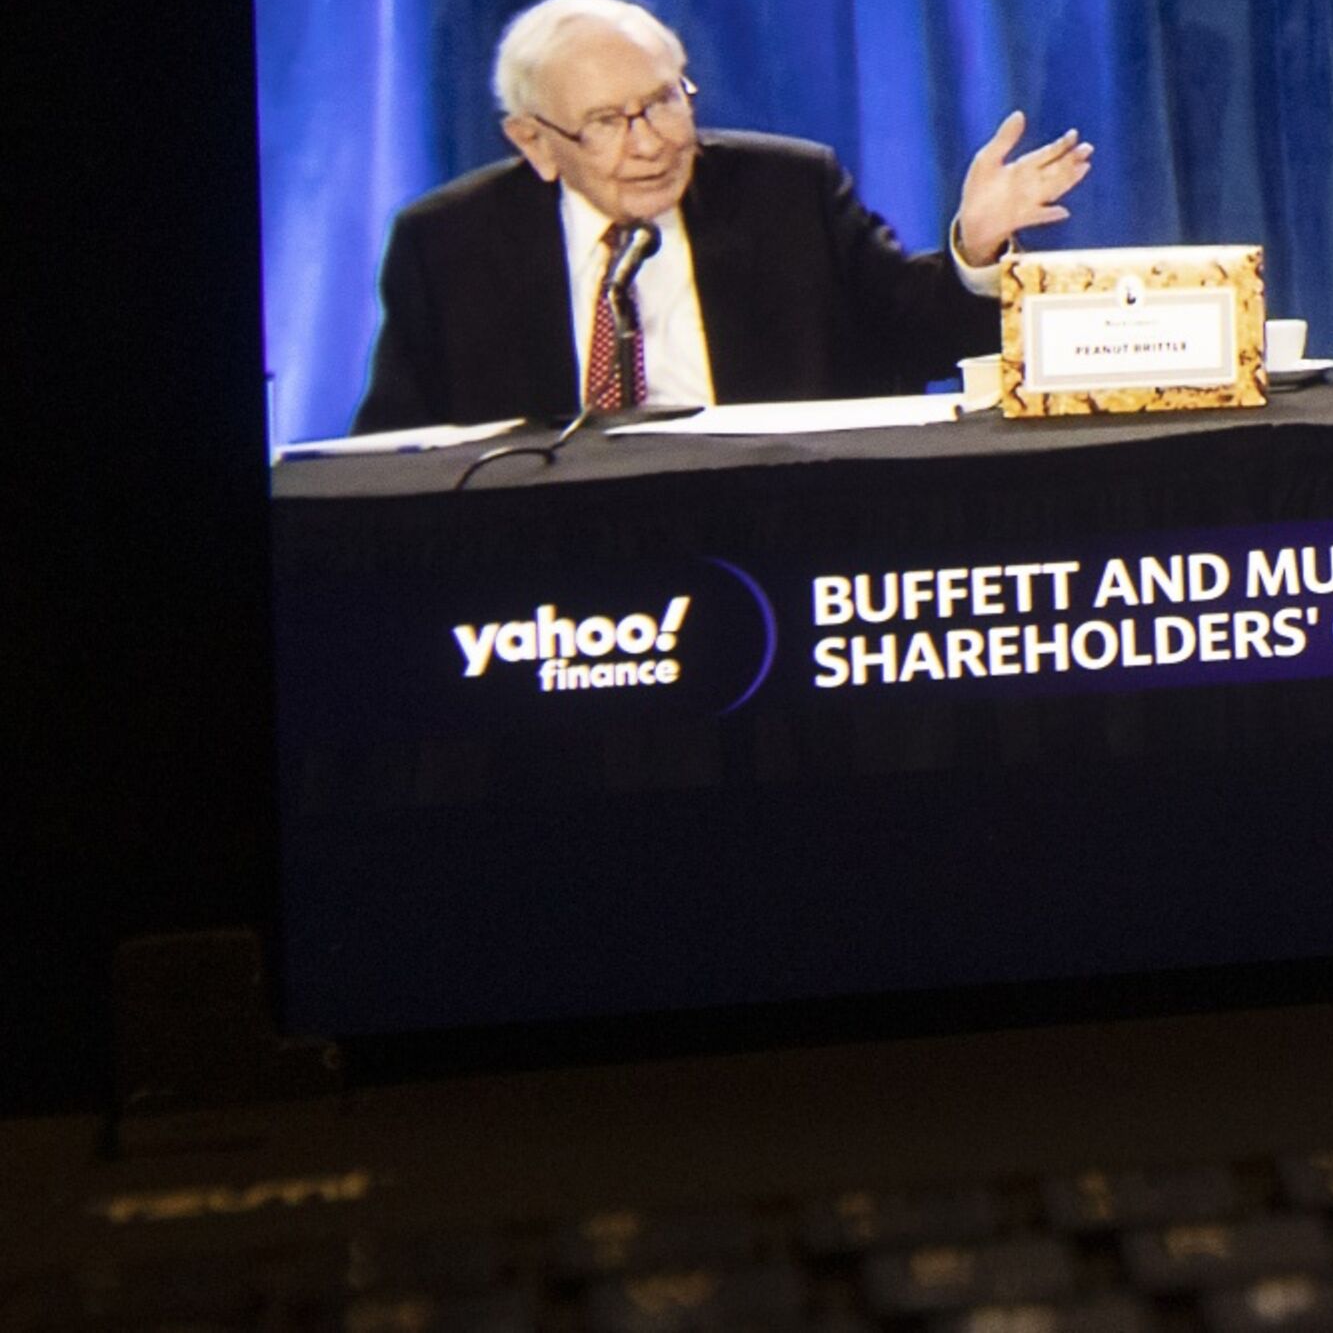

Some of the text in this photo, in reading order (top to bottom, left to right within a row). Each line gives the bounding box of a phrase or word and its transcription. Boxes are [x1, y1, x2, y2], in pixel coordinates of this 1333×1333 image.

[813, 561, 1080, 626] BUFFETT
[1092, 552, 1230, 609] AND
[453, 595, 690, 677] yahoo!
[537, 657, 680, 691] finance
[813, 606, 1319, 688] SHAREHOLDERS'
